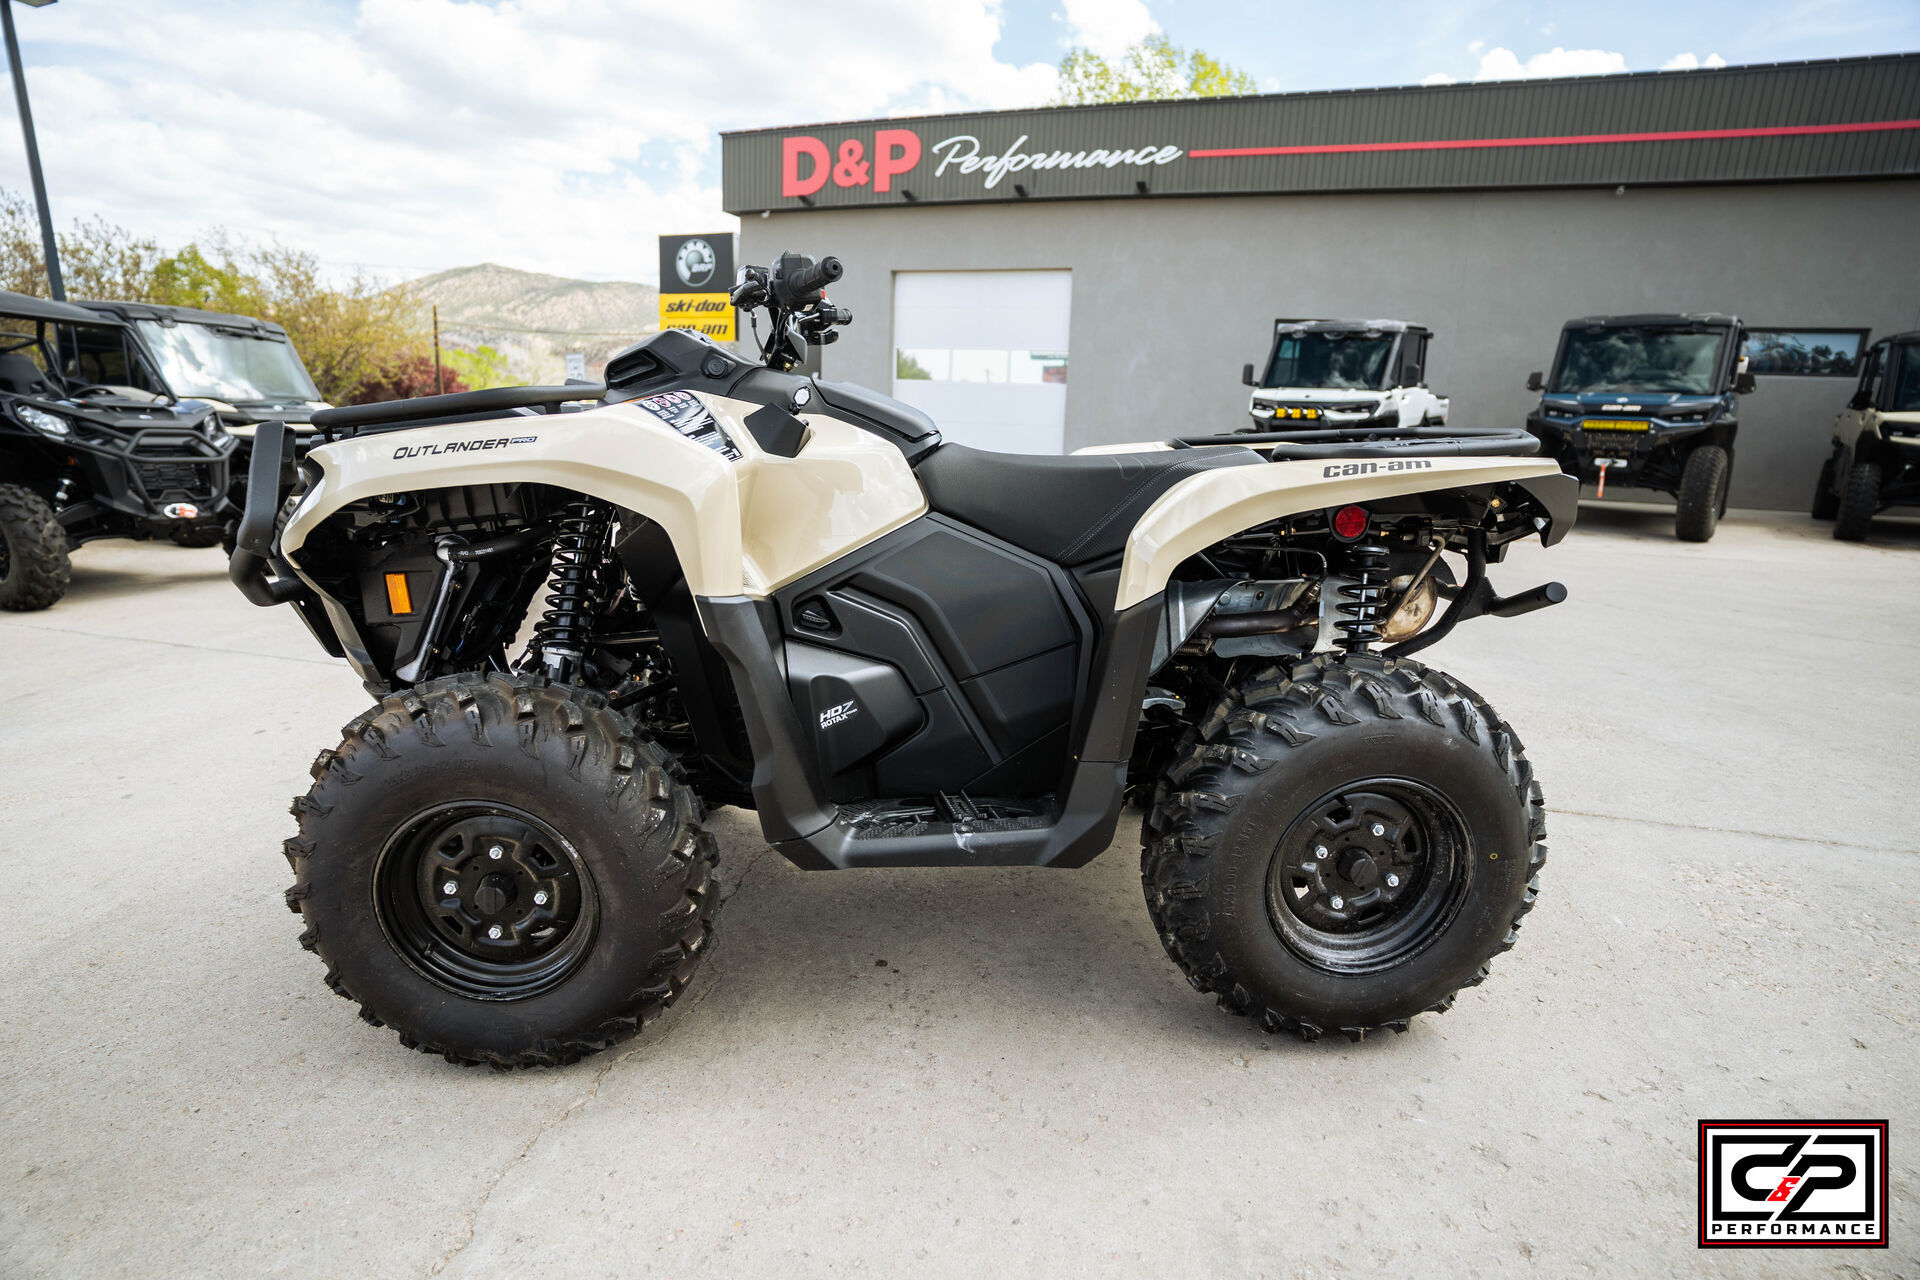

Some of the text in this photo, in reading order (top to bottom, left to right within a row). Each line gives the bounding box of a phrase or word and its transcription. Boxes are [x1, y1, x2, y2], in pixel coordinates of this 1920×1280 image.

[782, 129, 1183, 198] D&P Performance
[666, 299, 726, 312] ski-doo
[393, 438, 509, 460] OUTLANDER
[1323, 460, 1432, 478] can-am
[820, 700, 854, 722] HD7
[821, 713, 848, 729] ROTAX
